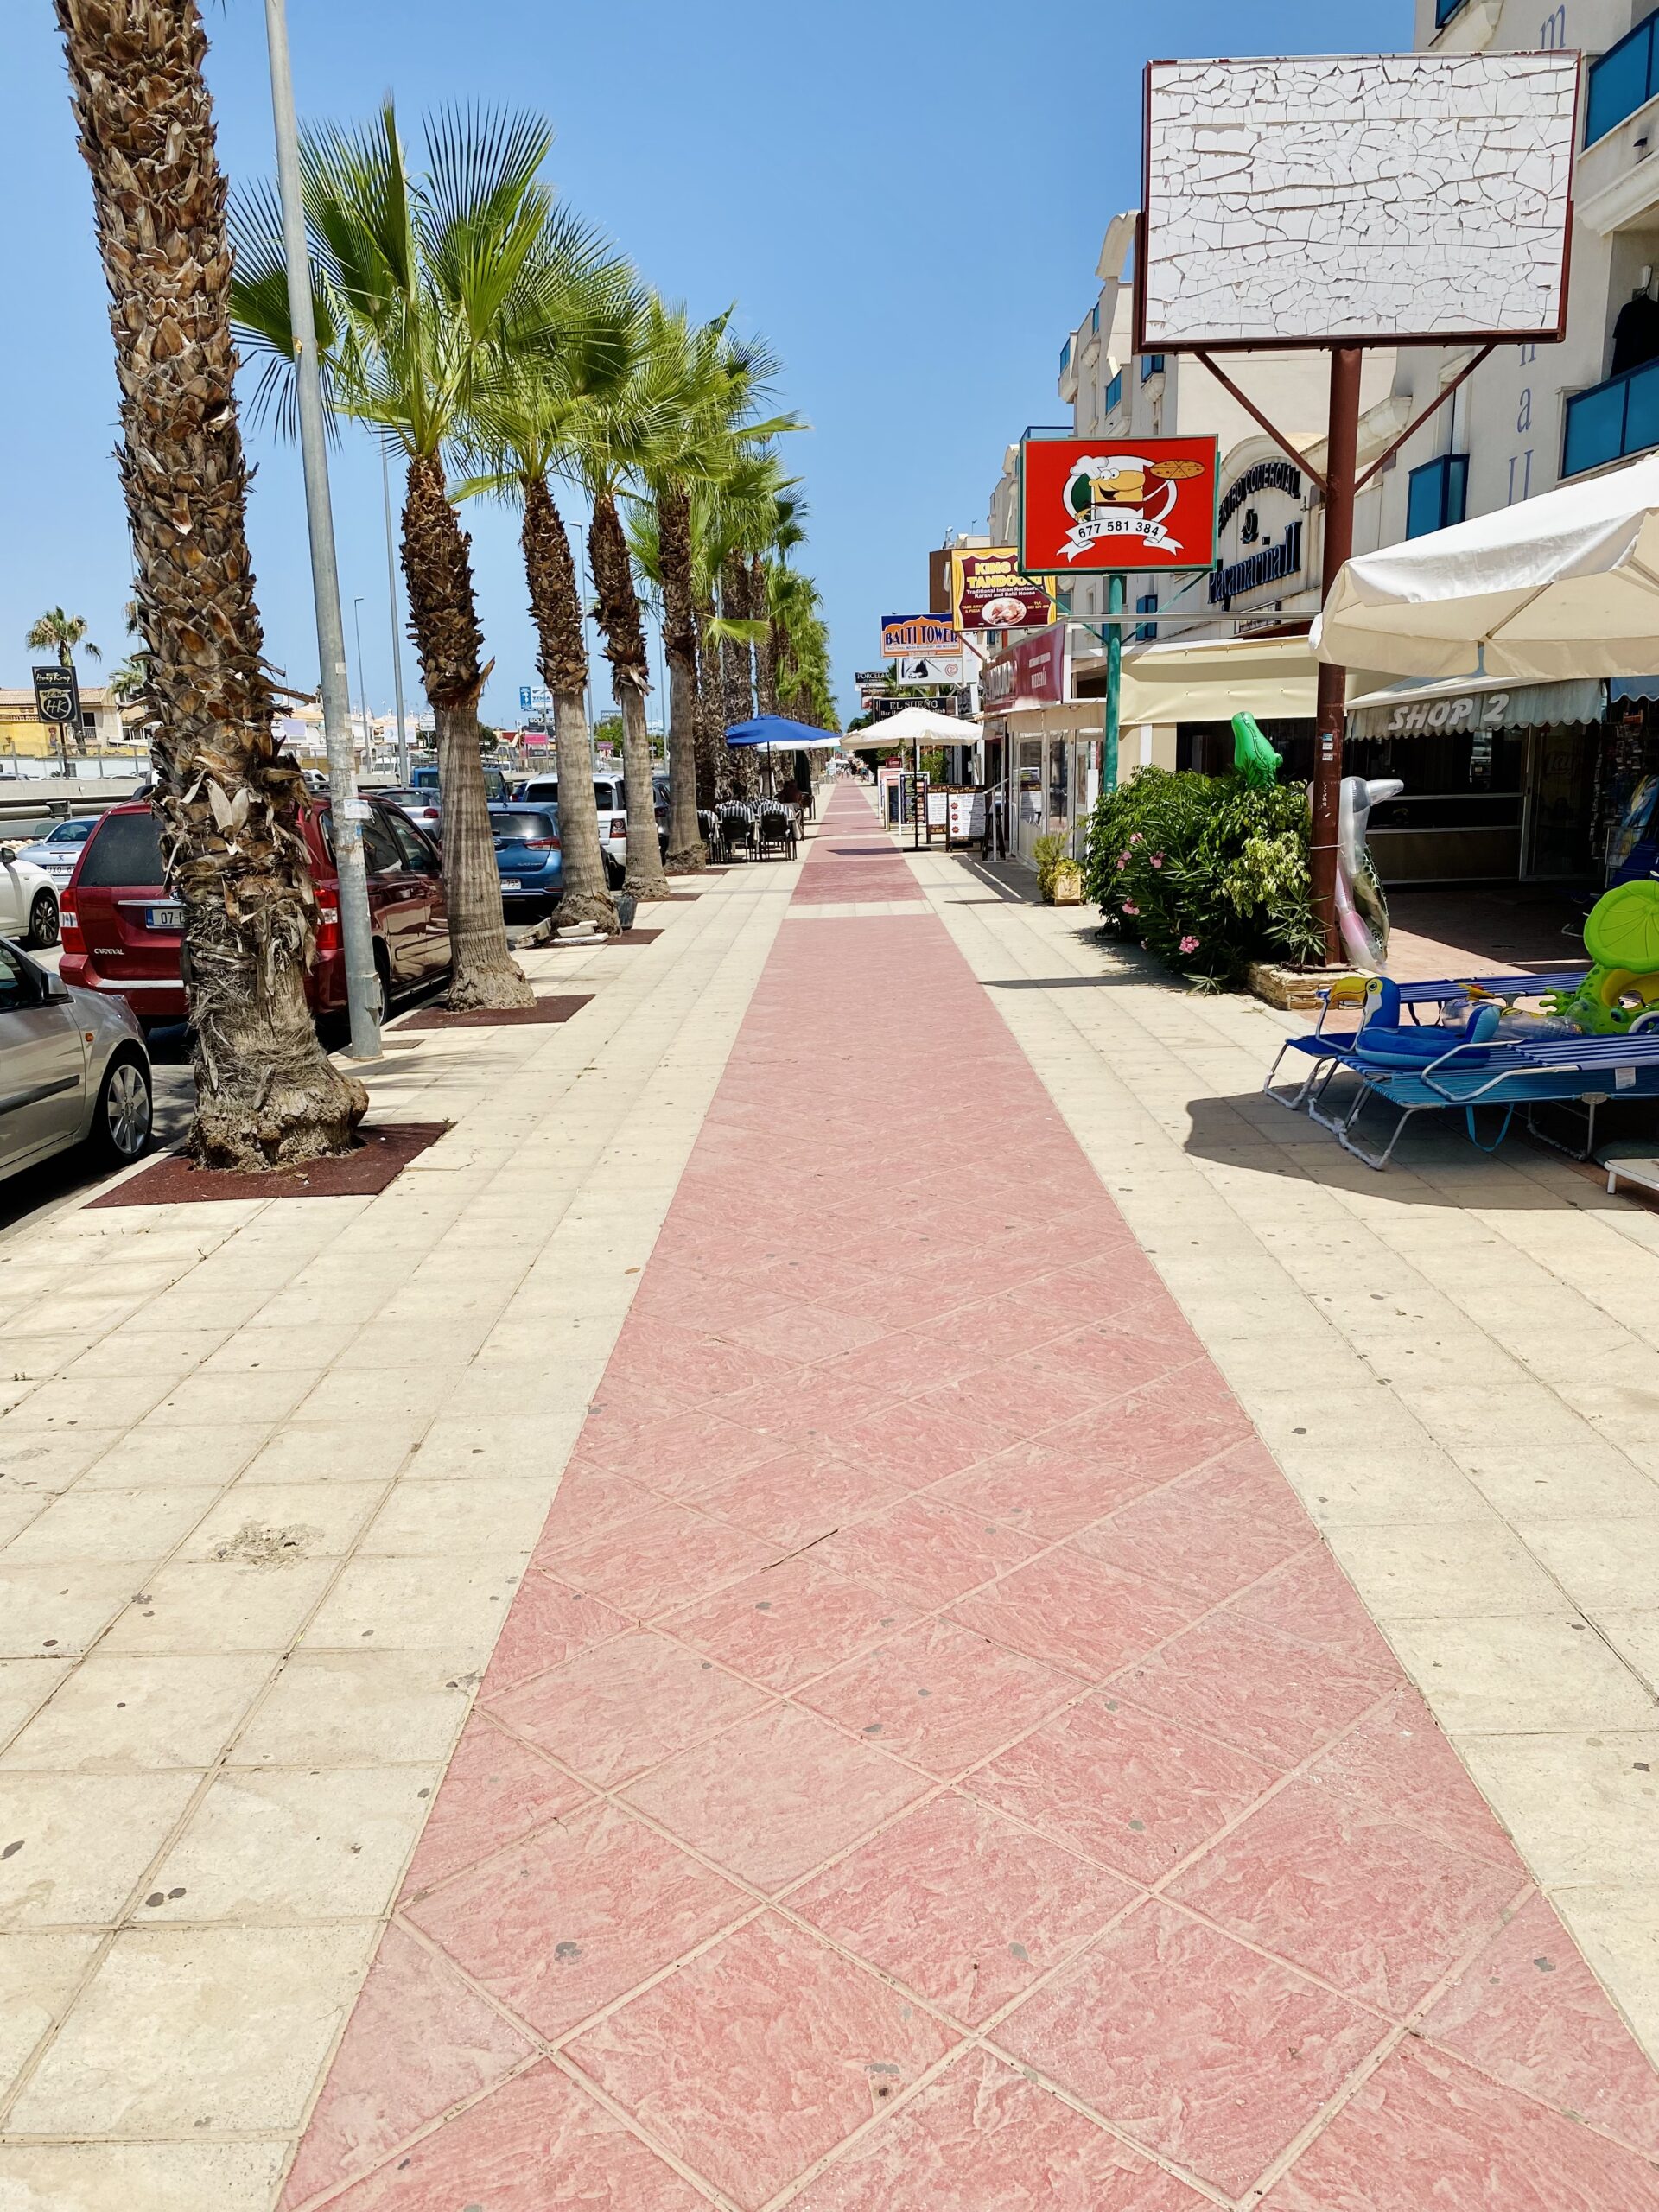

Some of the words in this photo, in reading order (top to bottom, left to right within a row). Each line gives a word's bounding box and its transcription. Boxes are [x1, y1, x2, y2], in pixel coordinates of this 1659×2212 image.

[1244, 462, 1301, 499] COMERCIAL
[1078, 523, 1102, 538] 677
[1107, 521, 1129, 532] 581
[1135, 521, 1159, 537] 384
[975, 562, 1011, 575] KING
[885, 626, 917, 645] BALTI
[919, 626, 958, 645] TOWER
[46, 699, 67, 714] HK
[889, 701, 903, 710] EL
[1388, 698, 1474, 732] SHOP
[1483, 693, 1510, 724] 2
